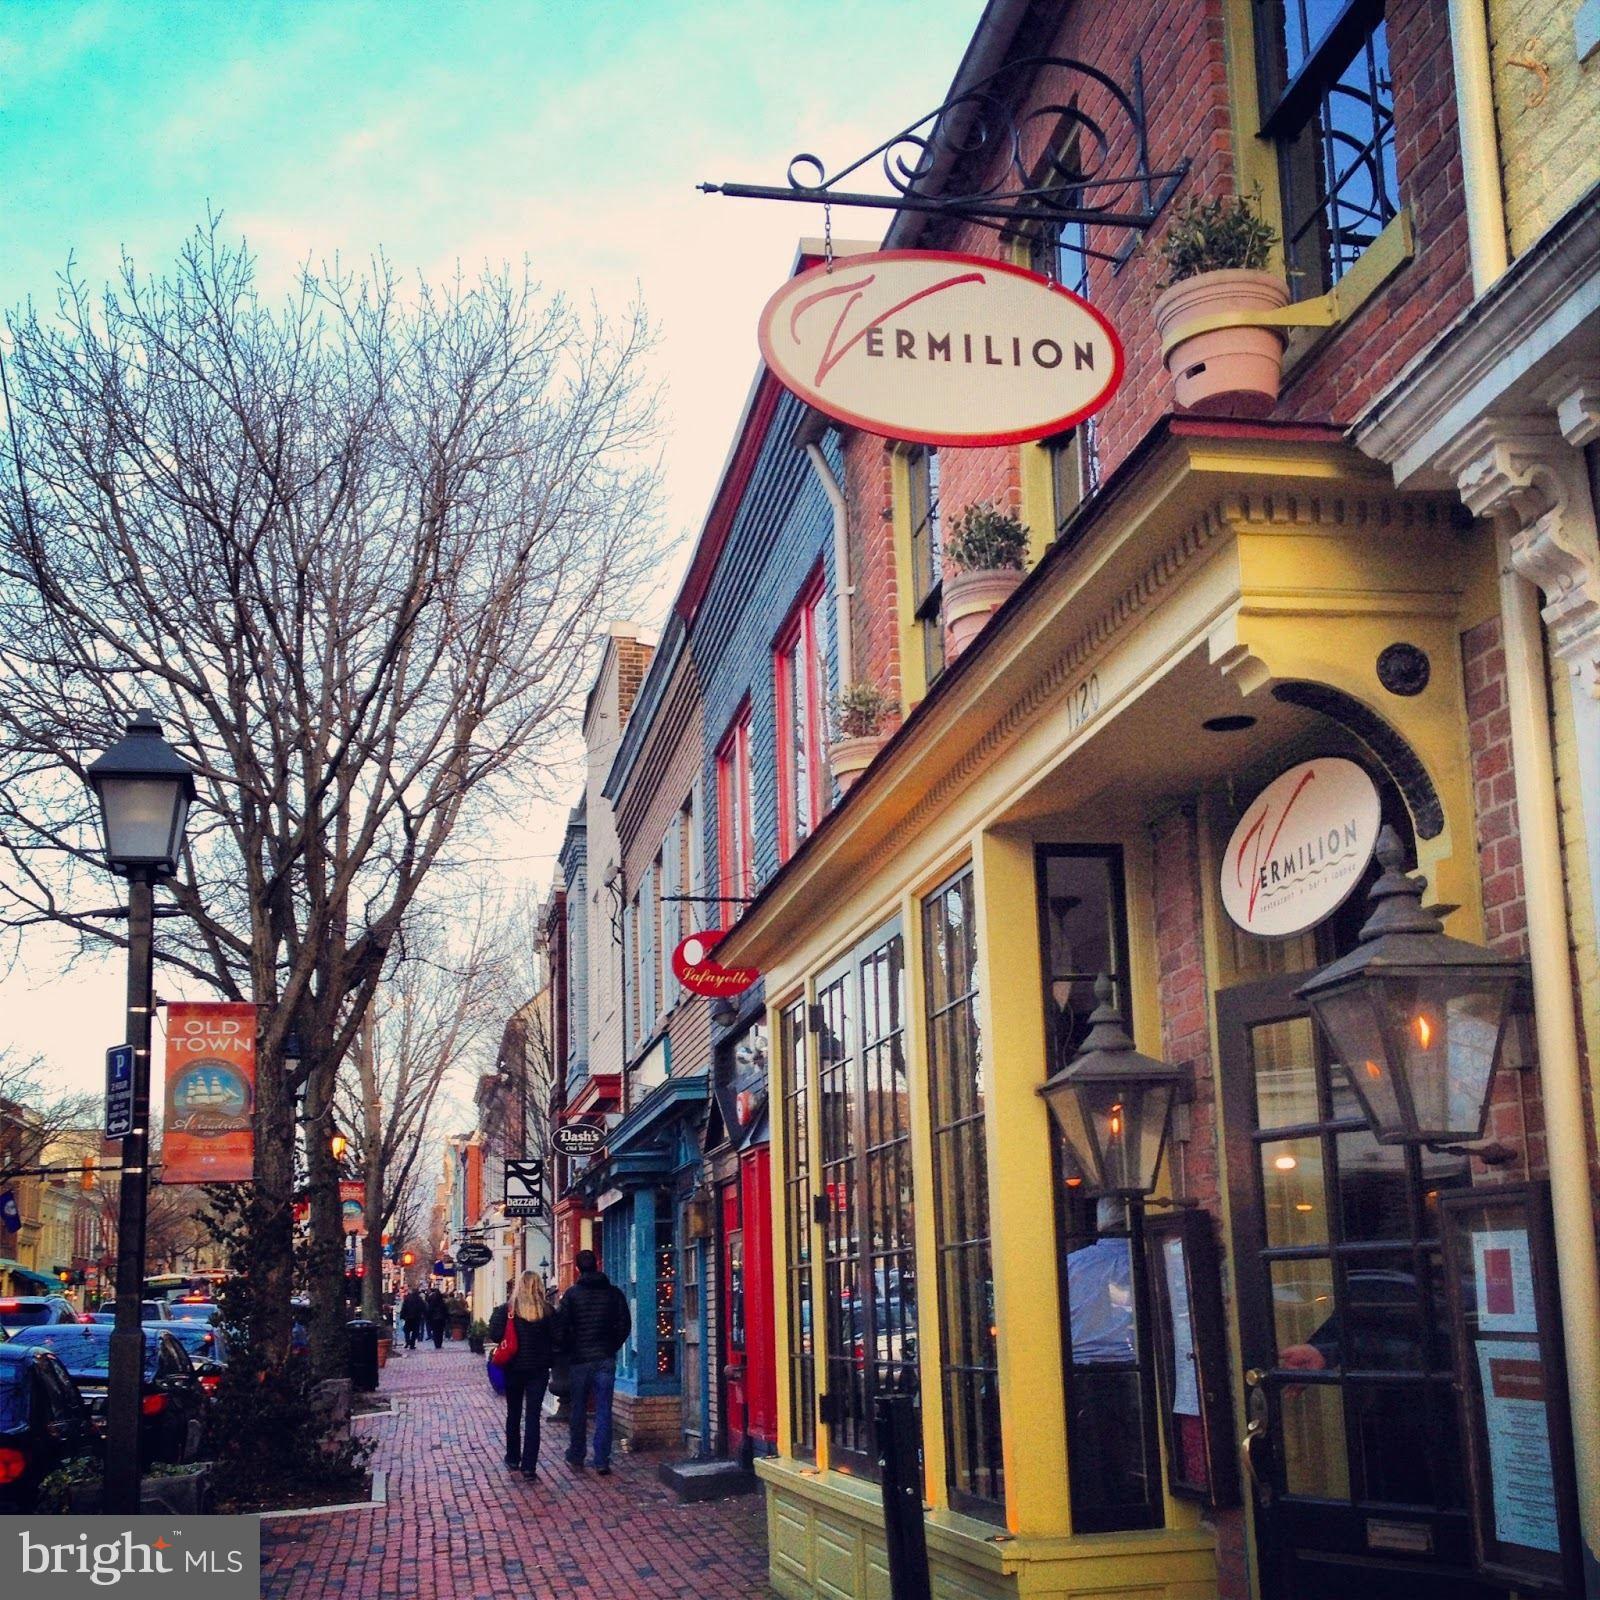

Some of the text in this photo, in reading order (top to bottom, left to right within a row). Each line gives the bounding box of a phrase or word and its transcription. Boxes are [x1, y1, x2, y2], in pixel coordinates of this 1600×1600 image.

[789, 273, 1095, 387] VERMILION
[1067, 673, 1100, 733] 1120
[1237, 769, 1358, 922] VERMILION
[682, 967, 752, 988] Lafayette
[184, 1020, 240, 1035] OLD
[170, 1037, 252, 1052] TOWN
[560, 1130, 600, 1142] Dash's
[507, 1197, 540, 1206] bazzak
